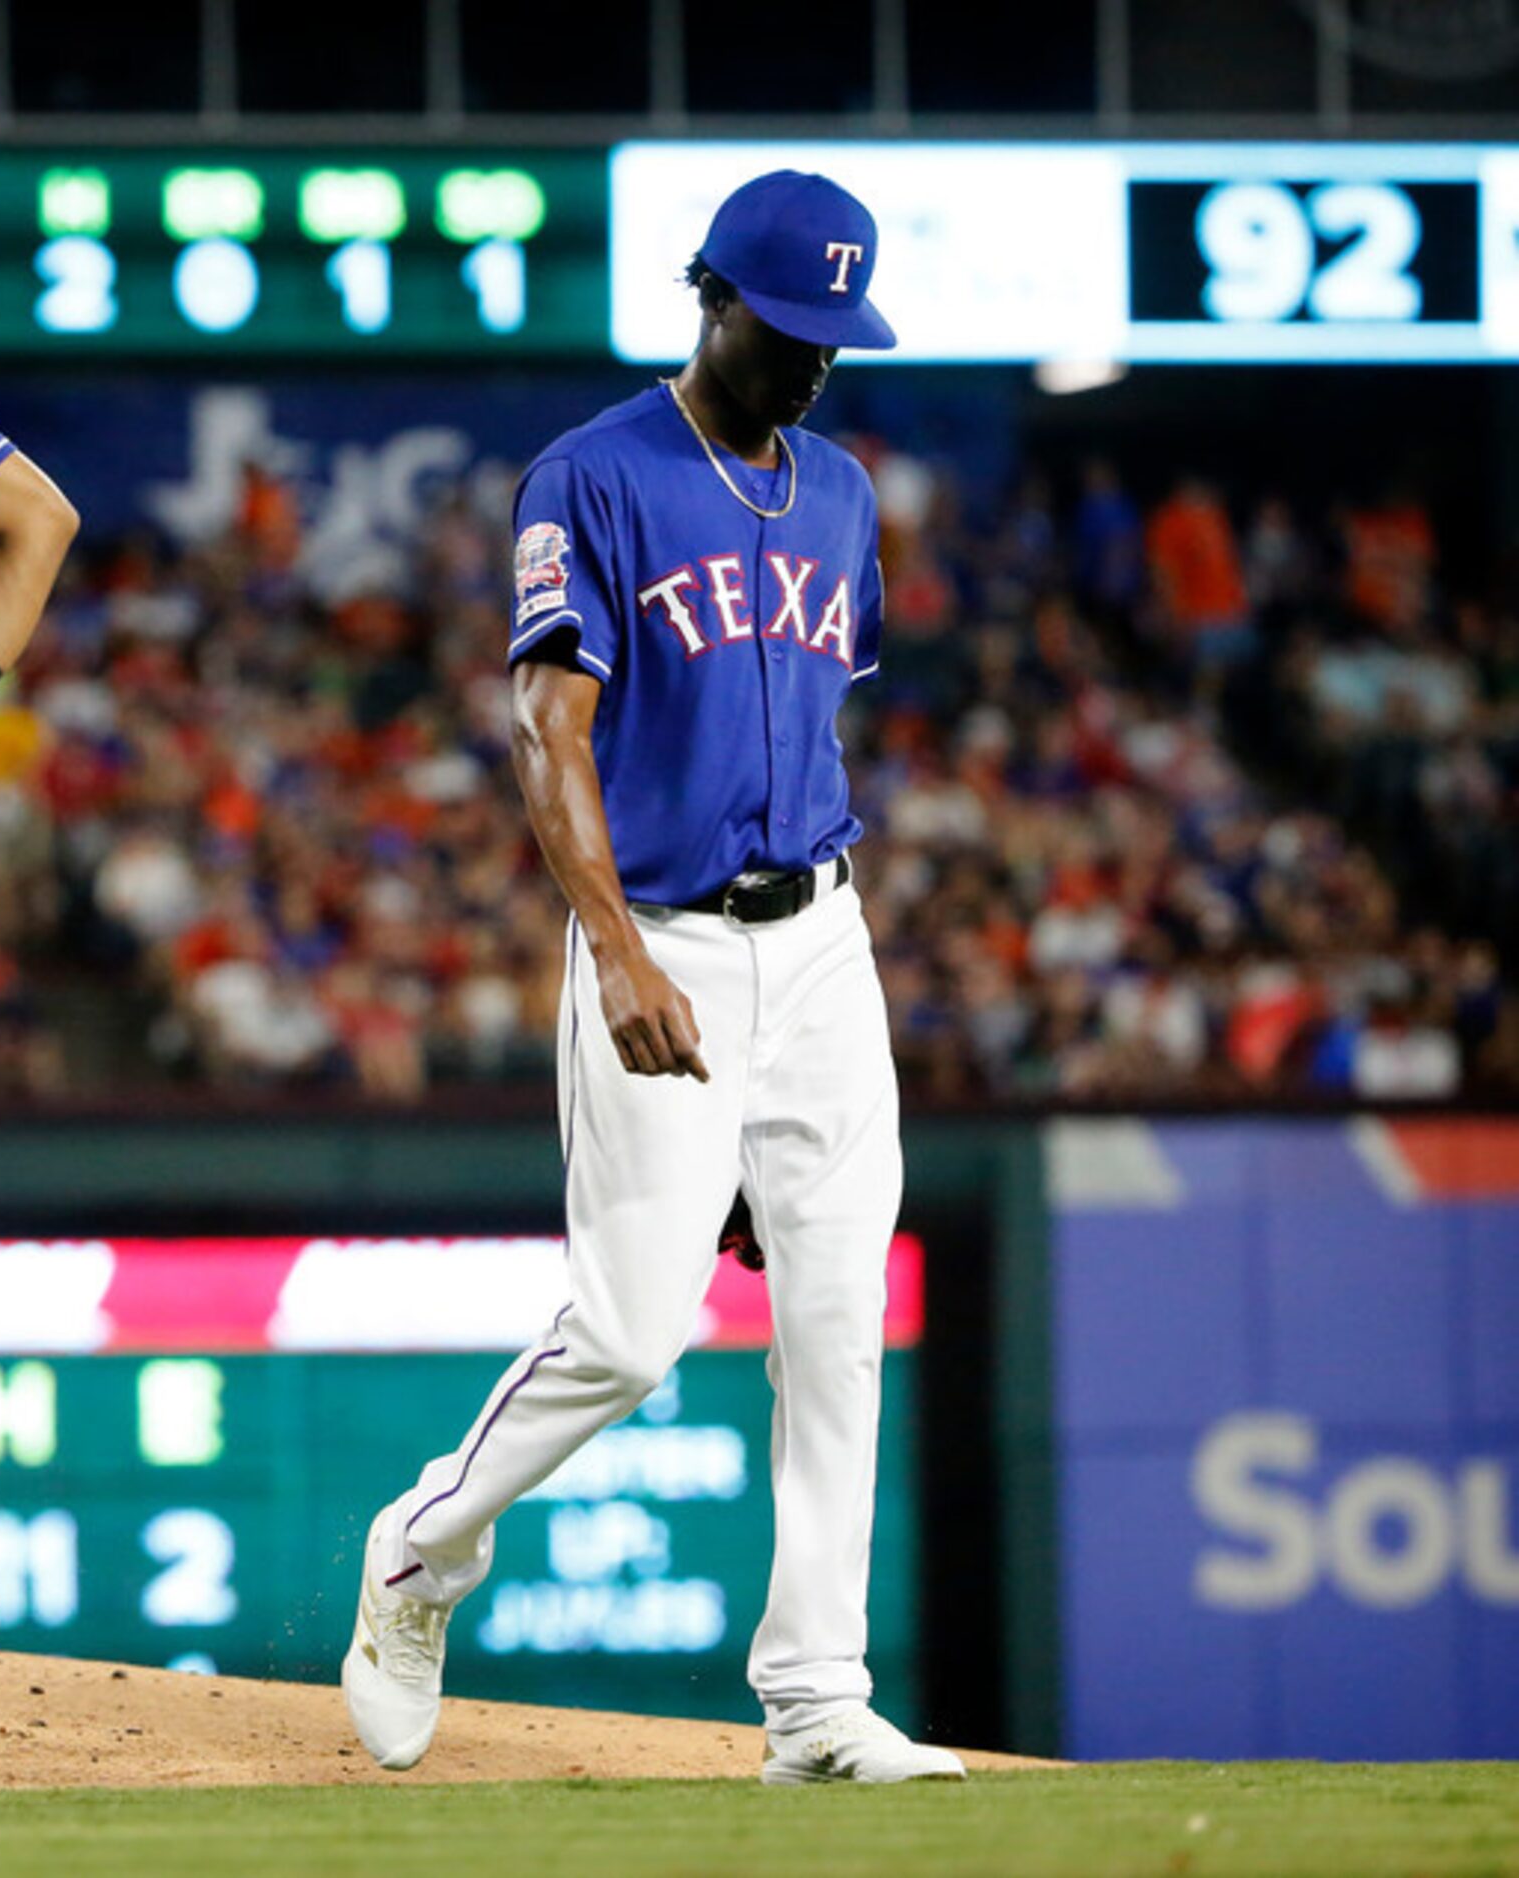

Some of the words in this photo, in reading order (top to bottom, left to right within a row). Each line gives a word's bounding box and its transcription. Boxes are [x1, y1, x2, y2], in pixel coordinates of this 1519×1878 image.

[34, 234, 118, 332] 2
[325, 236, 392, 333] 1
[460, 236, 527, 333] 1
[825, 241, 863, 292] T
[1195, 178, 1423, 324] 92
[137, 1359, 224, 1466] E
[140, 1507, 238, 1628] 2
